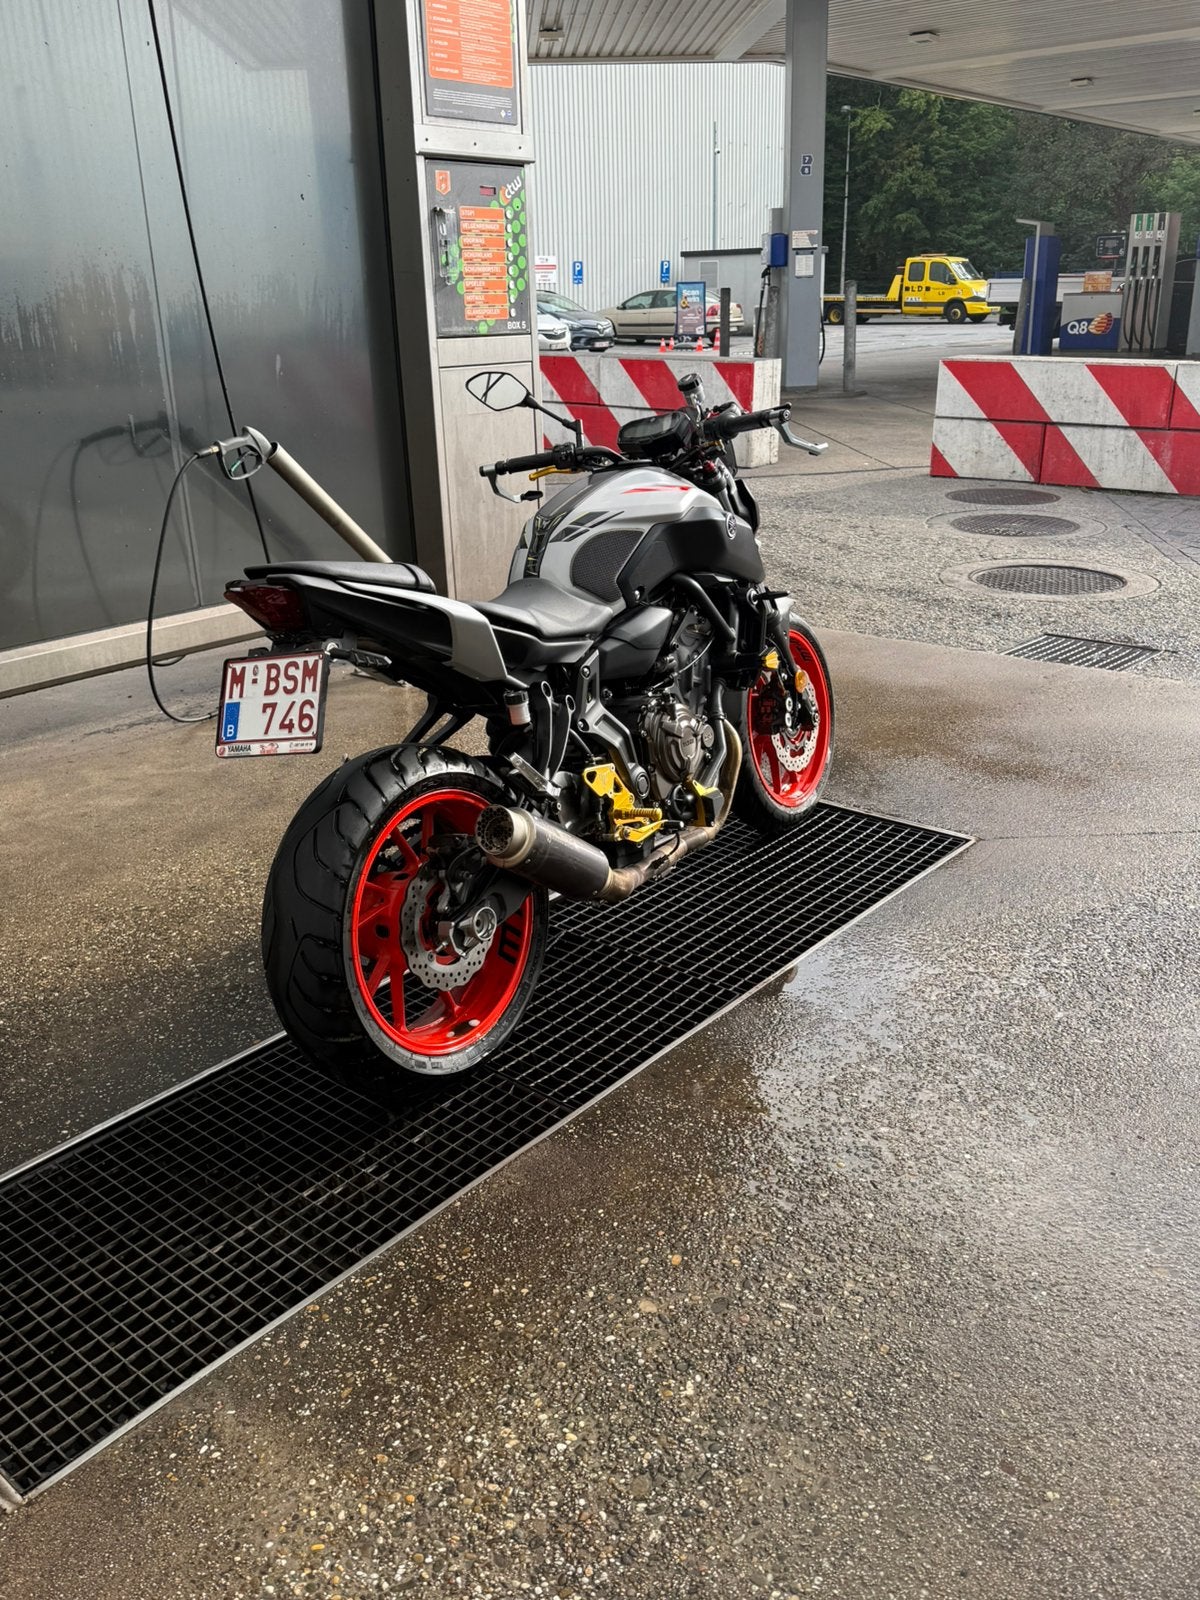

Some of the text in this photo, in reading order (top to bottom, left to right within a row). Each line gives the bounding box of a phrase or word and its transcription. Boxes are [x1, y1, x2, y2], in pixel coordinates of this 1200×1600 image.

[505, 175, 522, 199] ctw
[575, 262, 581, 275] P
[663, 261, 669, 273] P
[507, 321, 527, 329] BOX 5
[1067, 321, 1088, 335] Q8
[262, 699, 315, 736] 746
[227, 724, 235, 737] B
[227, 744, 252, 753] YAMAHA
